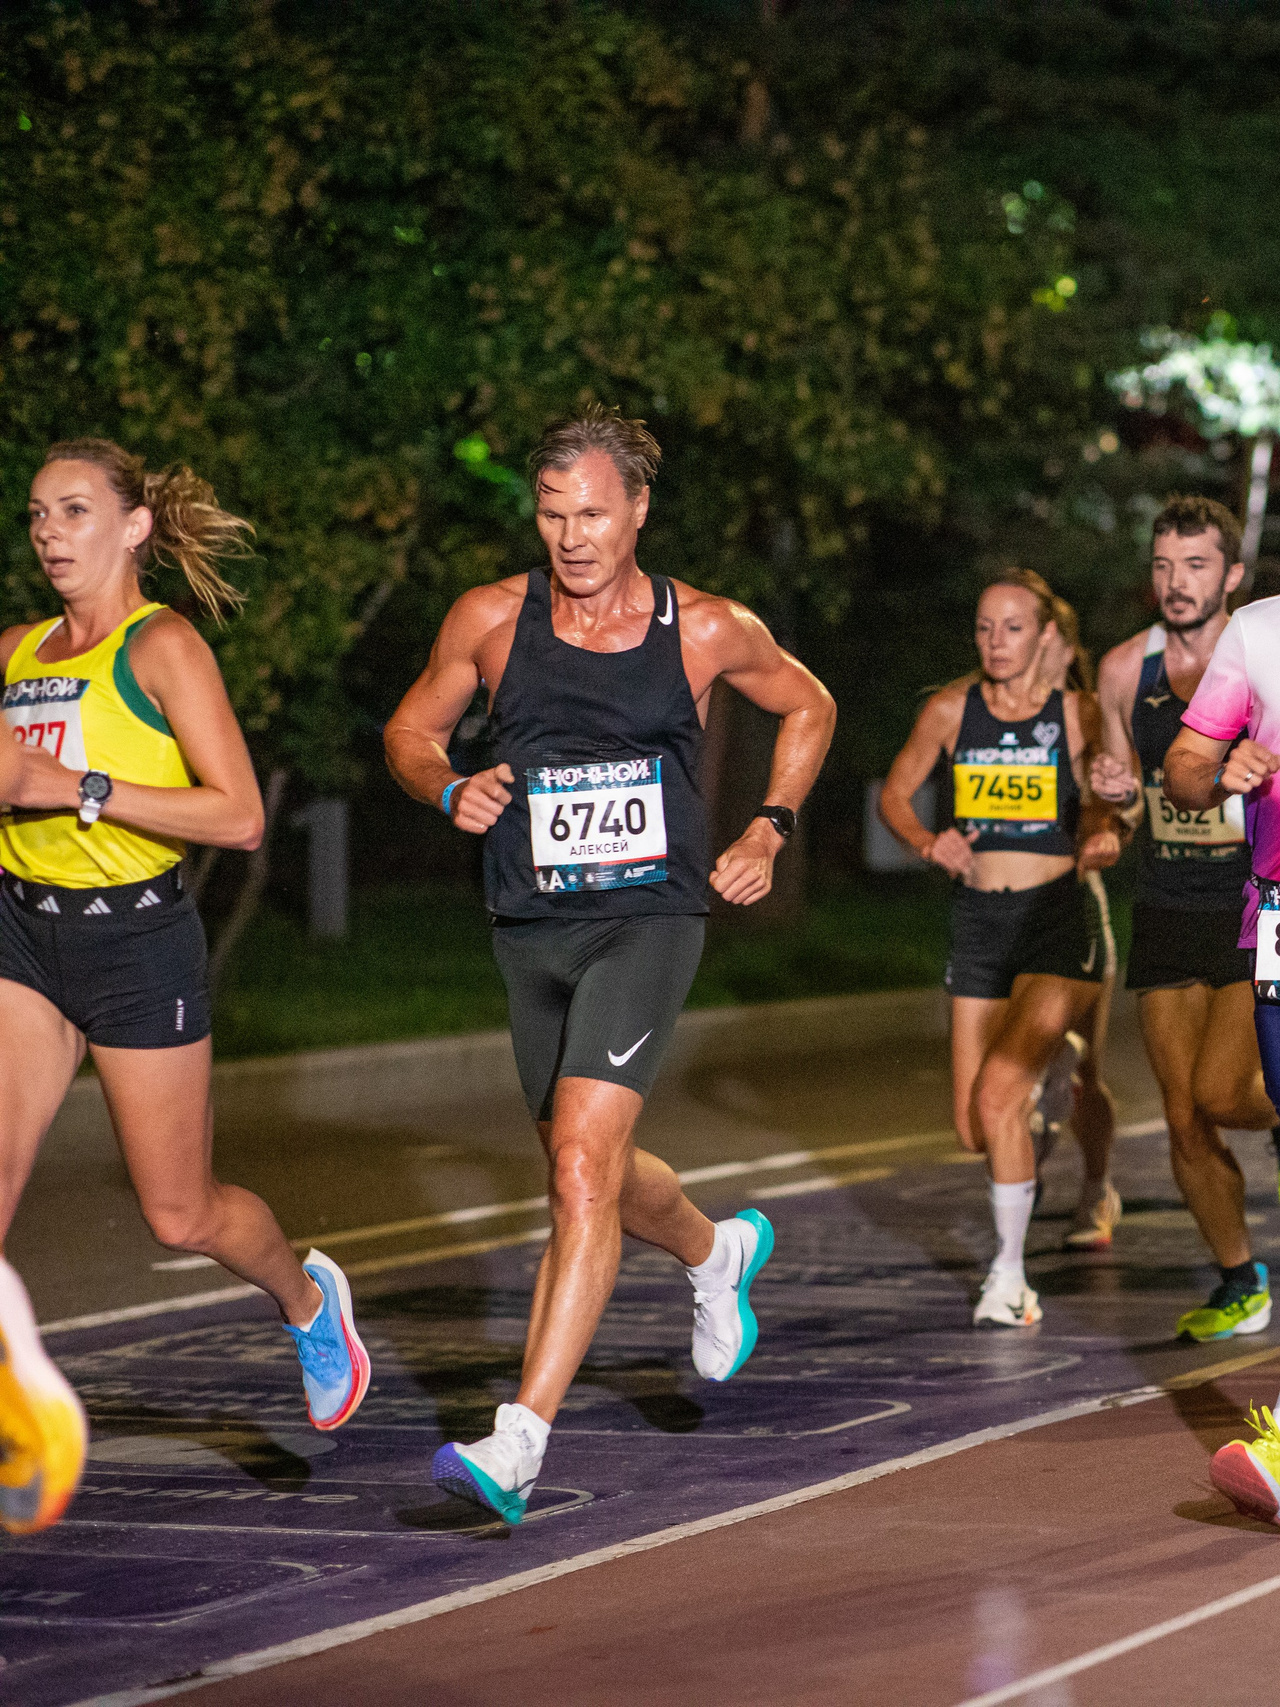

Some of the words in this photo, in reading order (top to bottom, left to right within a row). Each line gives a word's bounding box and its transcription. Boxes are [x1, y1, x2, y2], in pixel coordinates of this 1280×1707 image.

[969, 774, 1043, 801] 7455
[549, 798, 647, 842] 6740
[569, 839, 629, 857] АЛЕКСЕЙ
